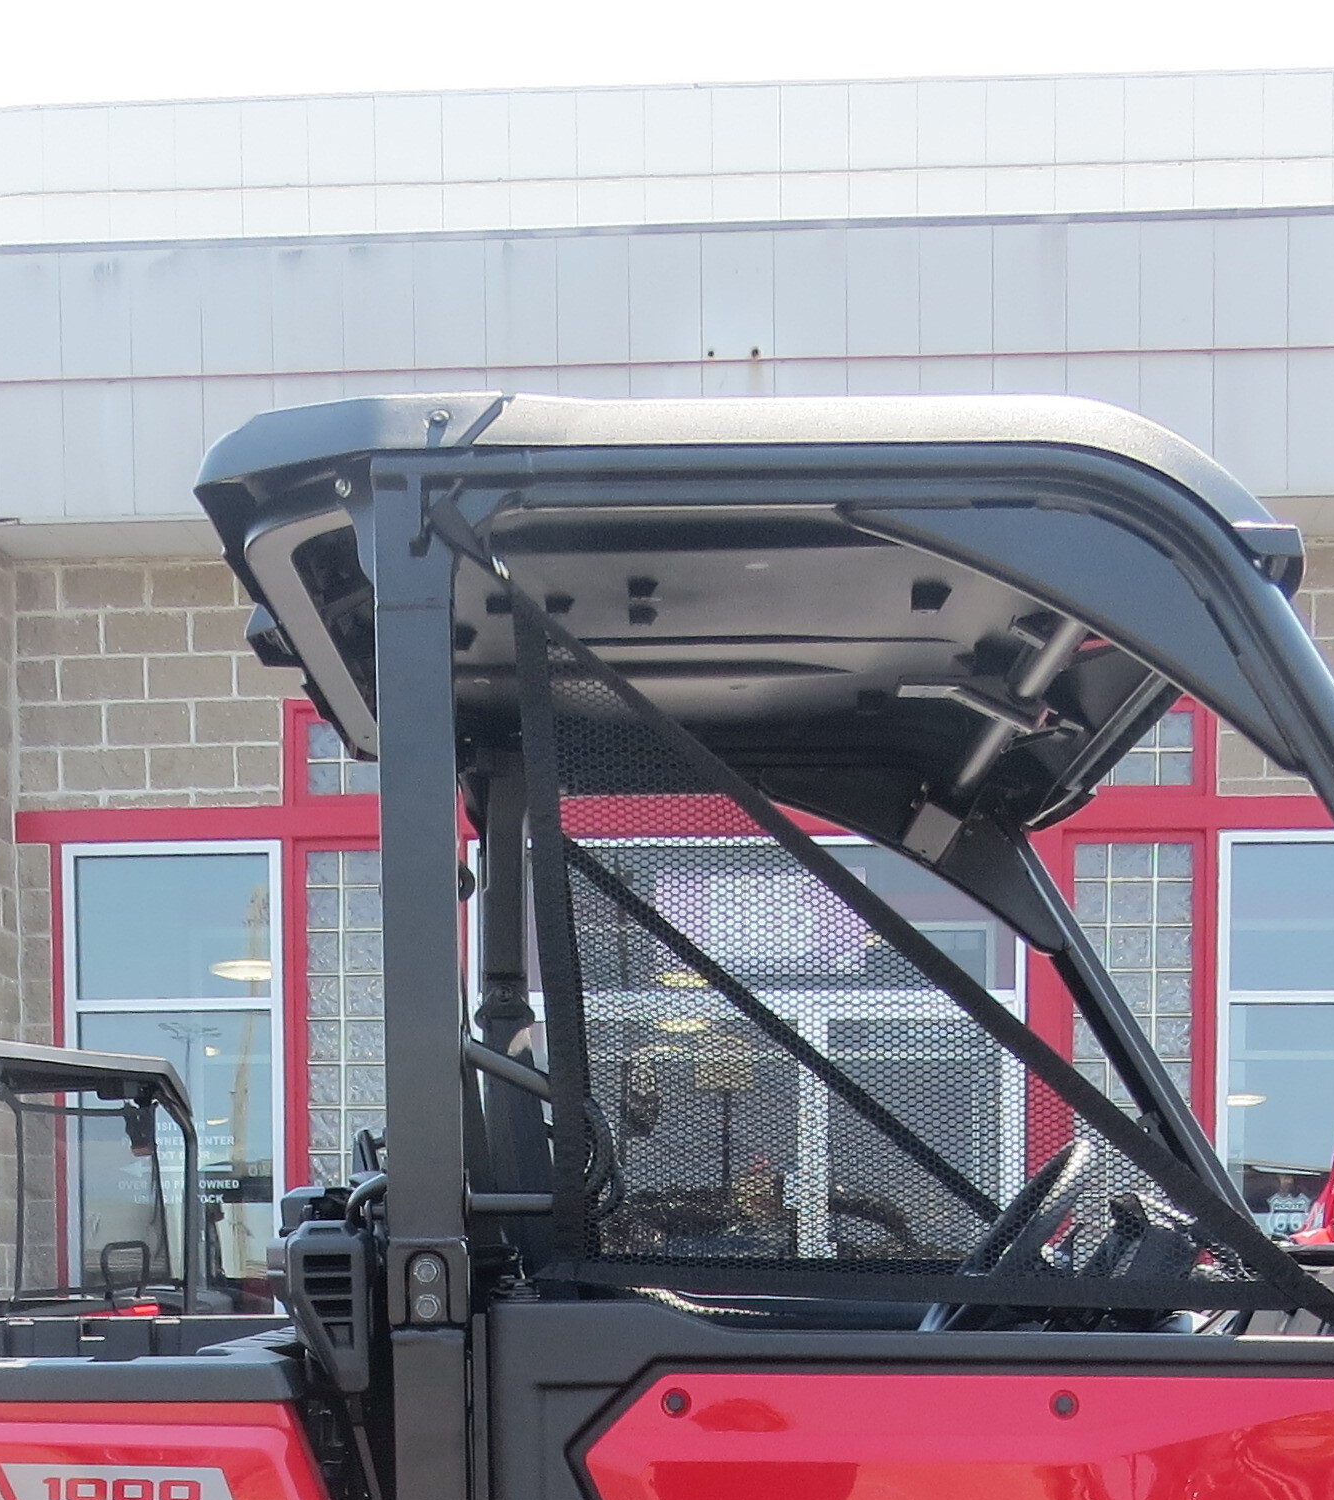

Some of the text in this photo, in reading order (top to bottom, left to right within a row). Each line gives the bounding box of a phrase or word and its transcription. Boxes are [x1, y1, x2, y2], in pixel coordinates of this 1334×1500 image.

[156, 1121, 179, 1131] ISIT
[199, 1135, 235, 1145] ENTER
[1275, 1212, 1302, 1232] 66
